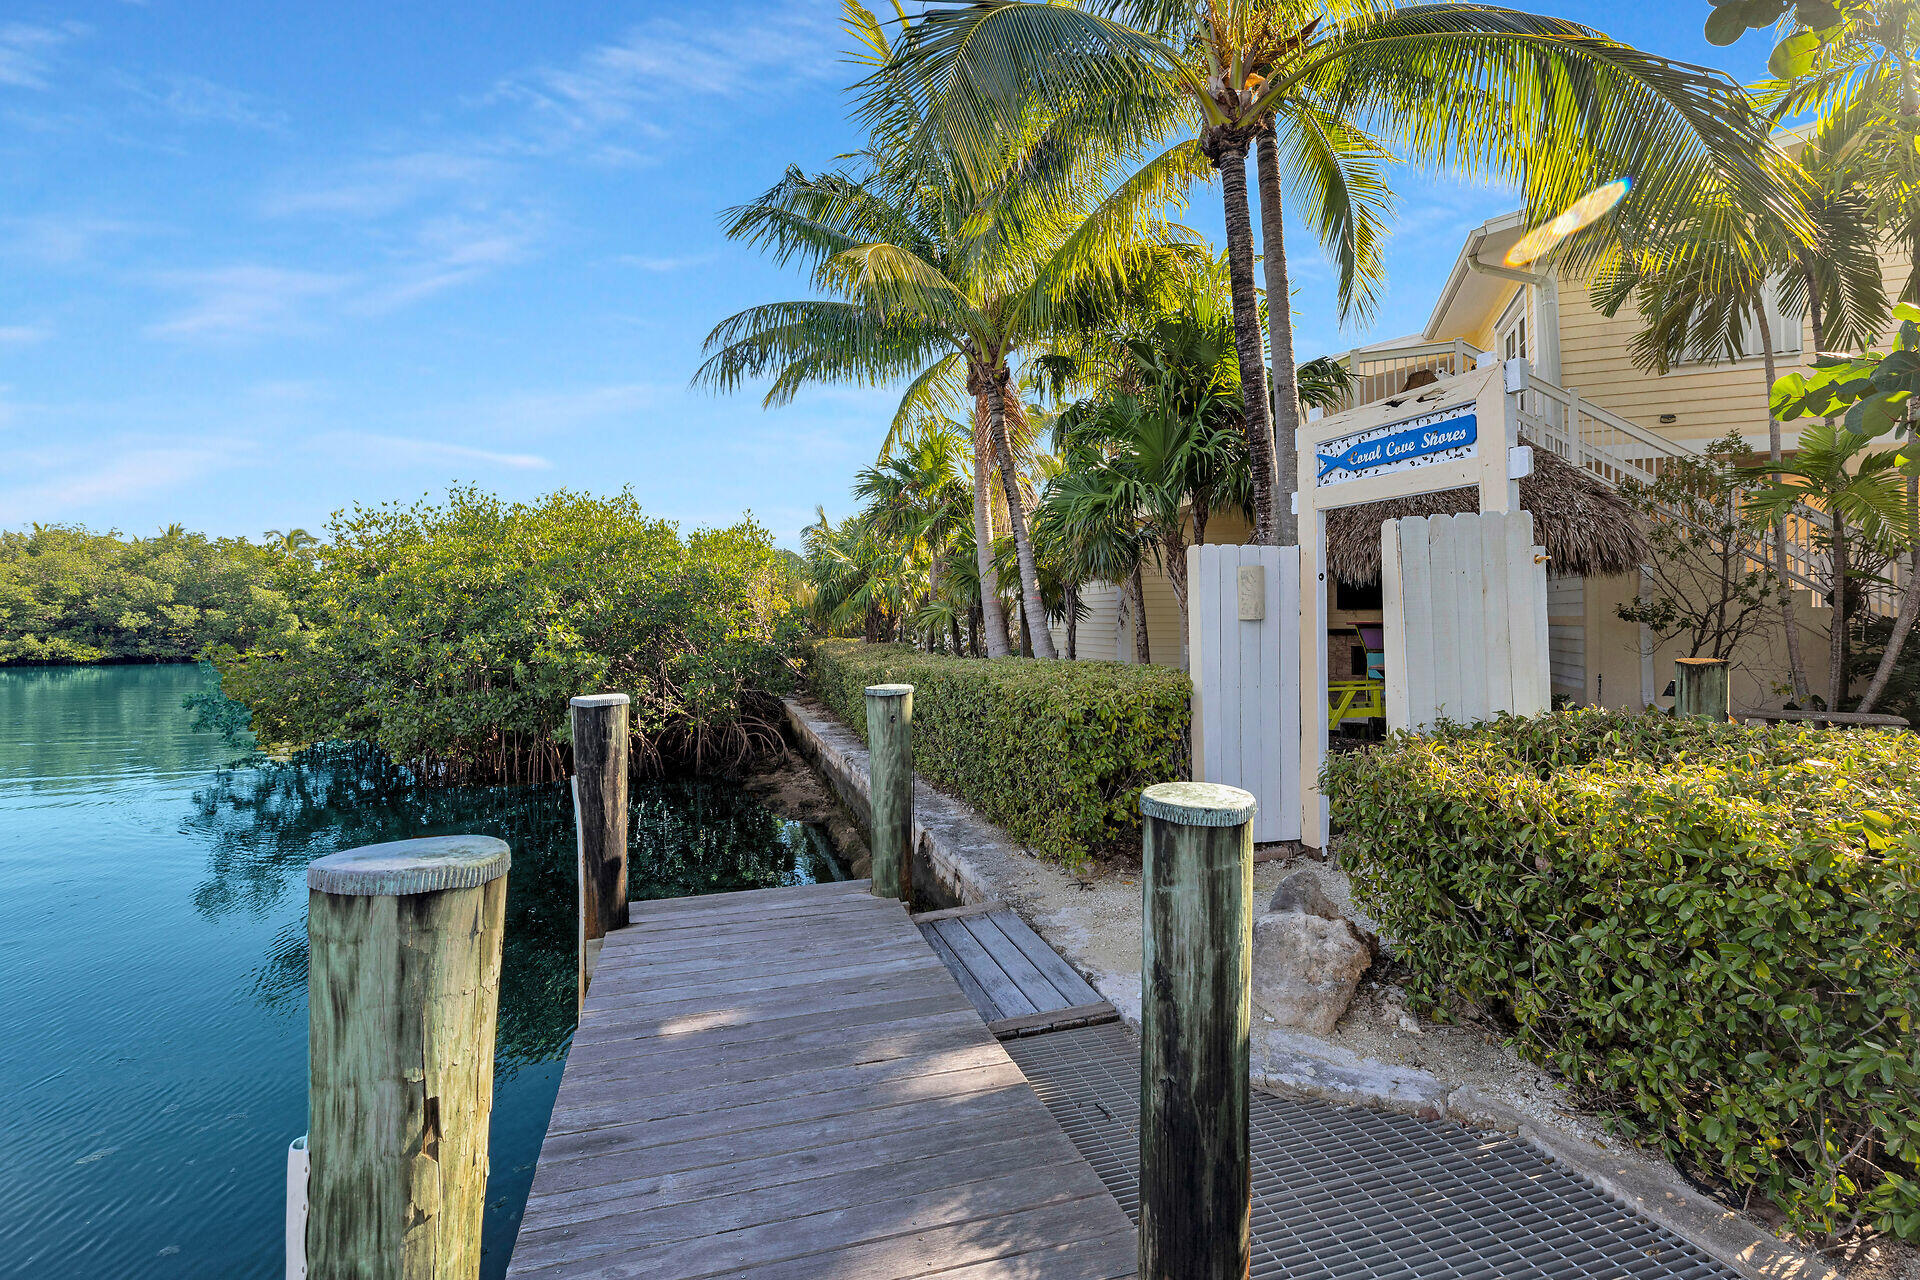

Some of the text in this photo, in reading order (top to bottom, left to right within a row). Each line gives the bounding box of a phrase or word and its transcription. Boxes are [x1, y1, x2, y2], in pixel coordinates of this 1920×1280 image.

[1349, 428, 1467, 465] Coral Cove Shores
